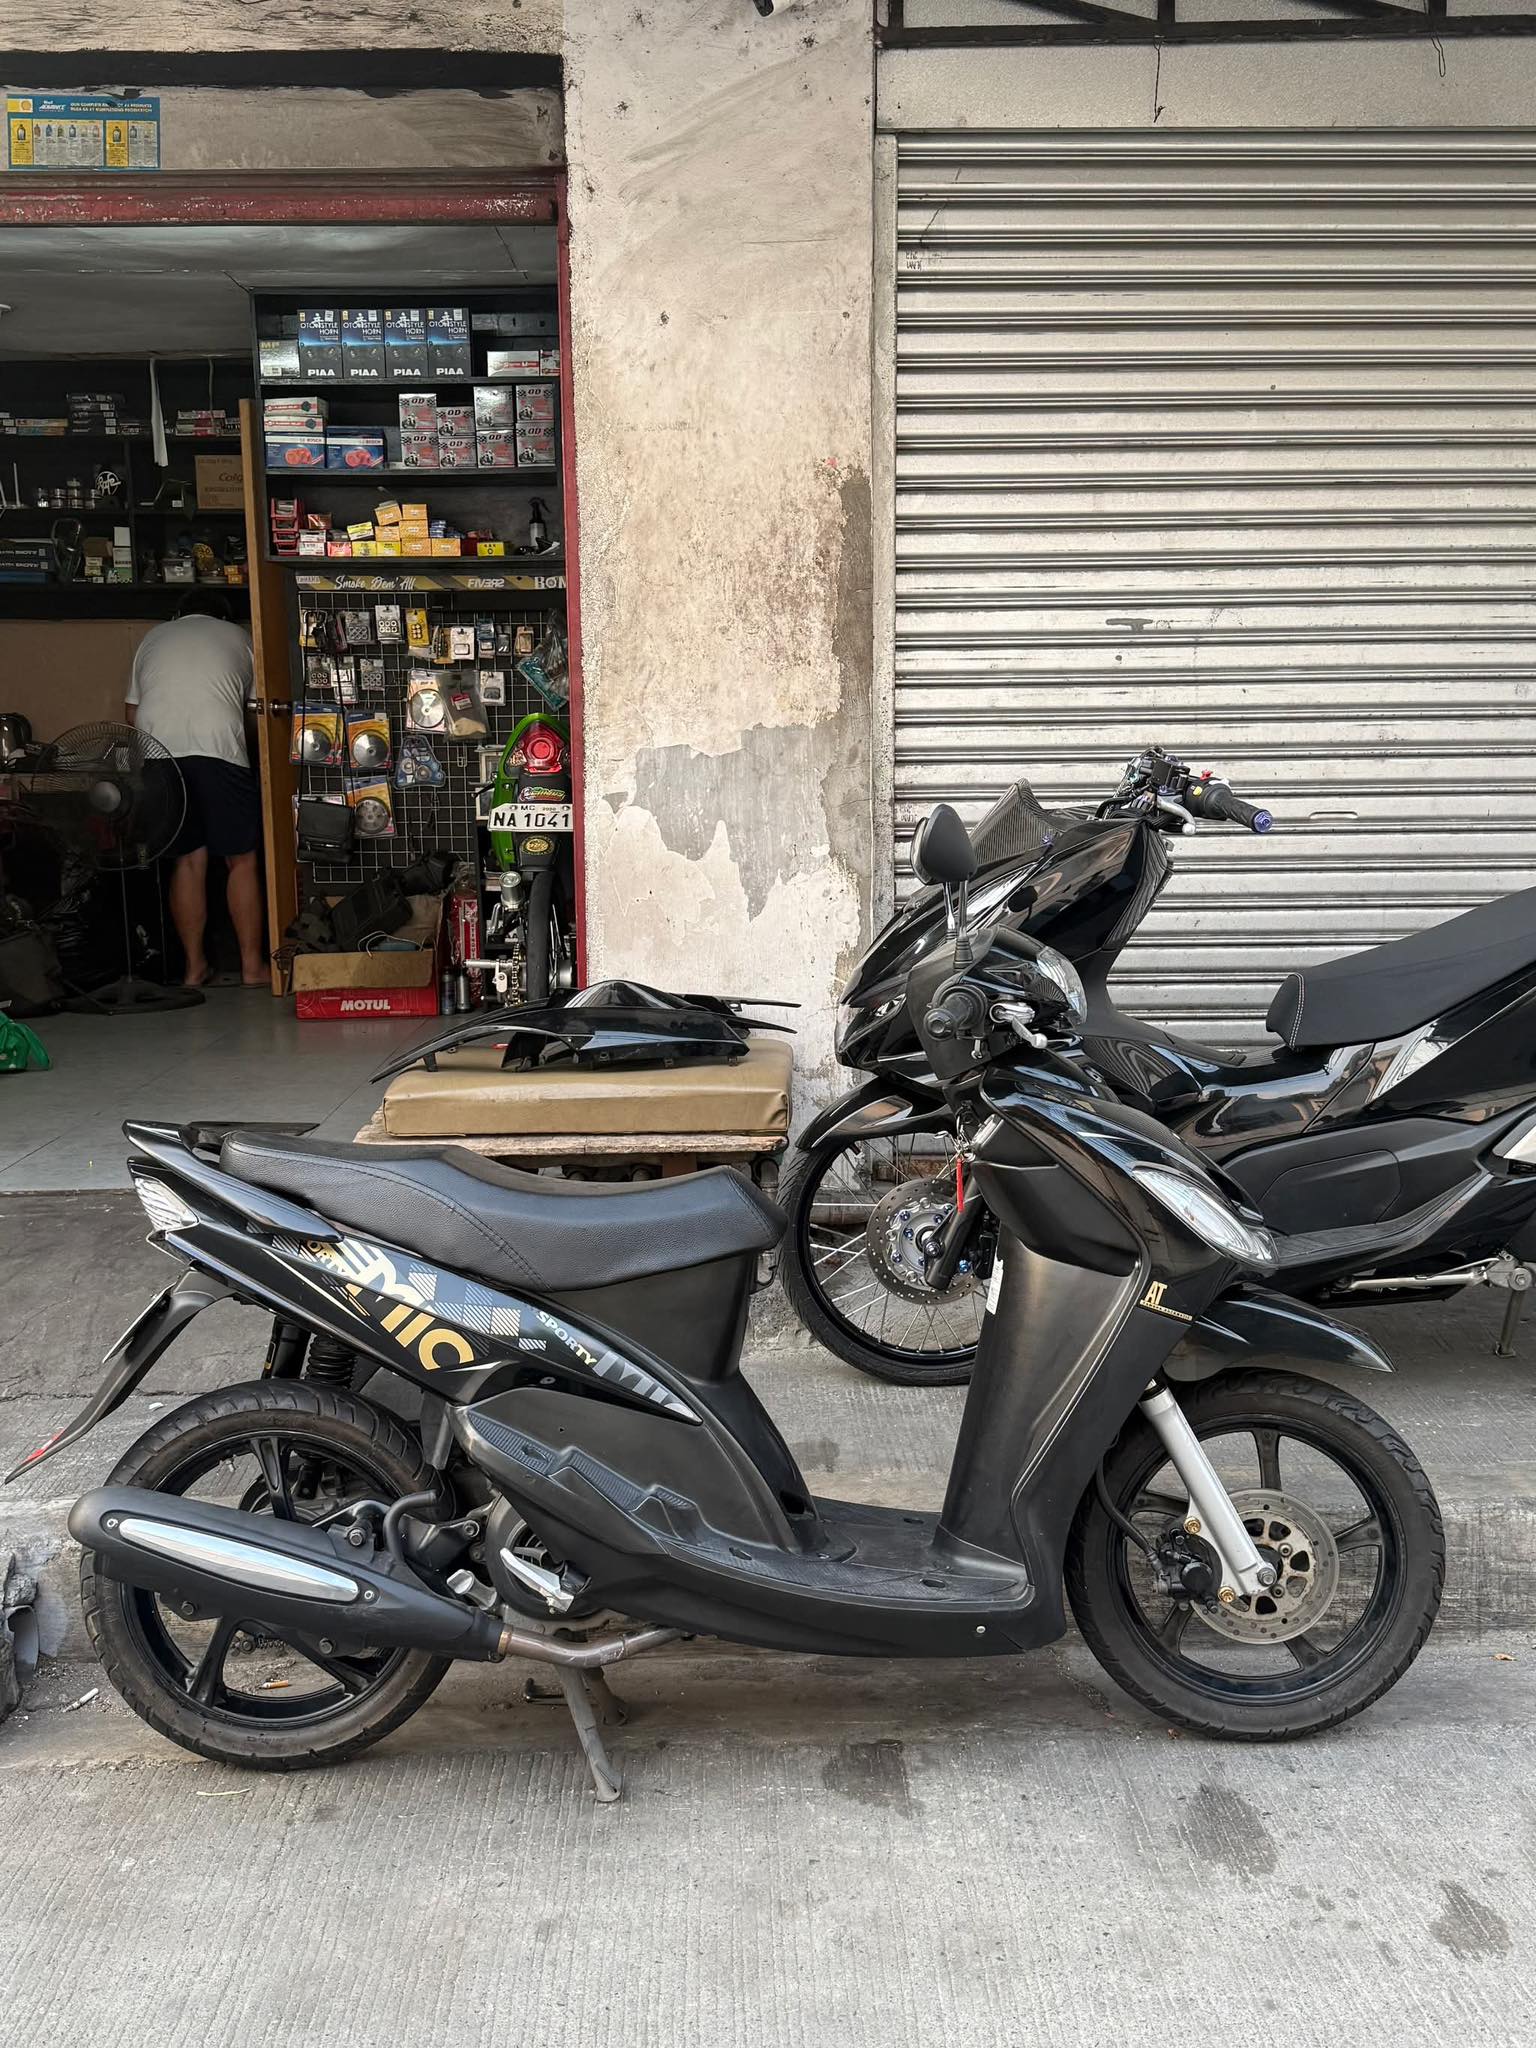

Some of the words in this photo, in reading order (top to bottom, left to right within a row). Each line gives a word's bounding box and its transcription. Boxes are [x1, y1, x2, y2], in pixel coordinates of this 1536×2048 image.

[307, 368, 336, 377] PIAA
[350, 368, 379, 377] PIAA
[393, 368, 422, 376] PIAA
[436, 367, 464, 376] PIAA
[335, 574, 366, 590] Smoke
[400, 575, 416, 590] All
[493, 811, 517, 827] NA
[524, 813, 569, 828] 1041
[340, 999, 391, 1012] MOTUL
[1143, 1280, 1168, 1305] AT
[536, 1310, 598, 1366] SPORTY
